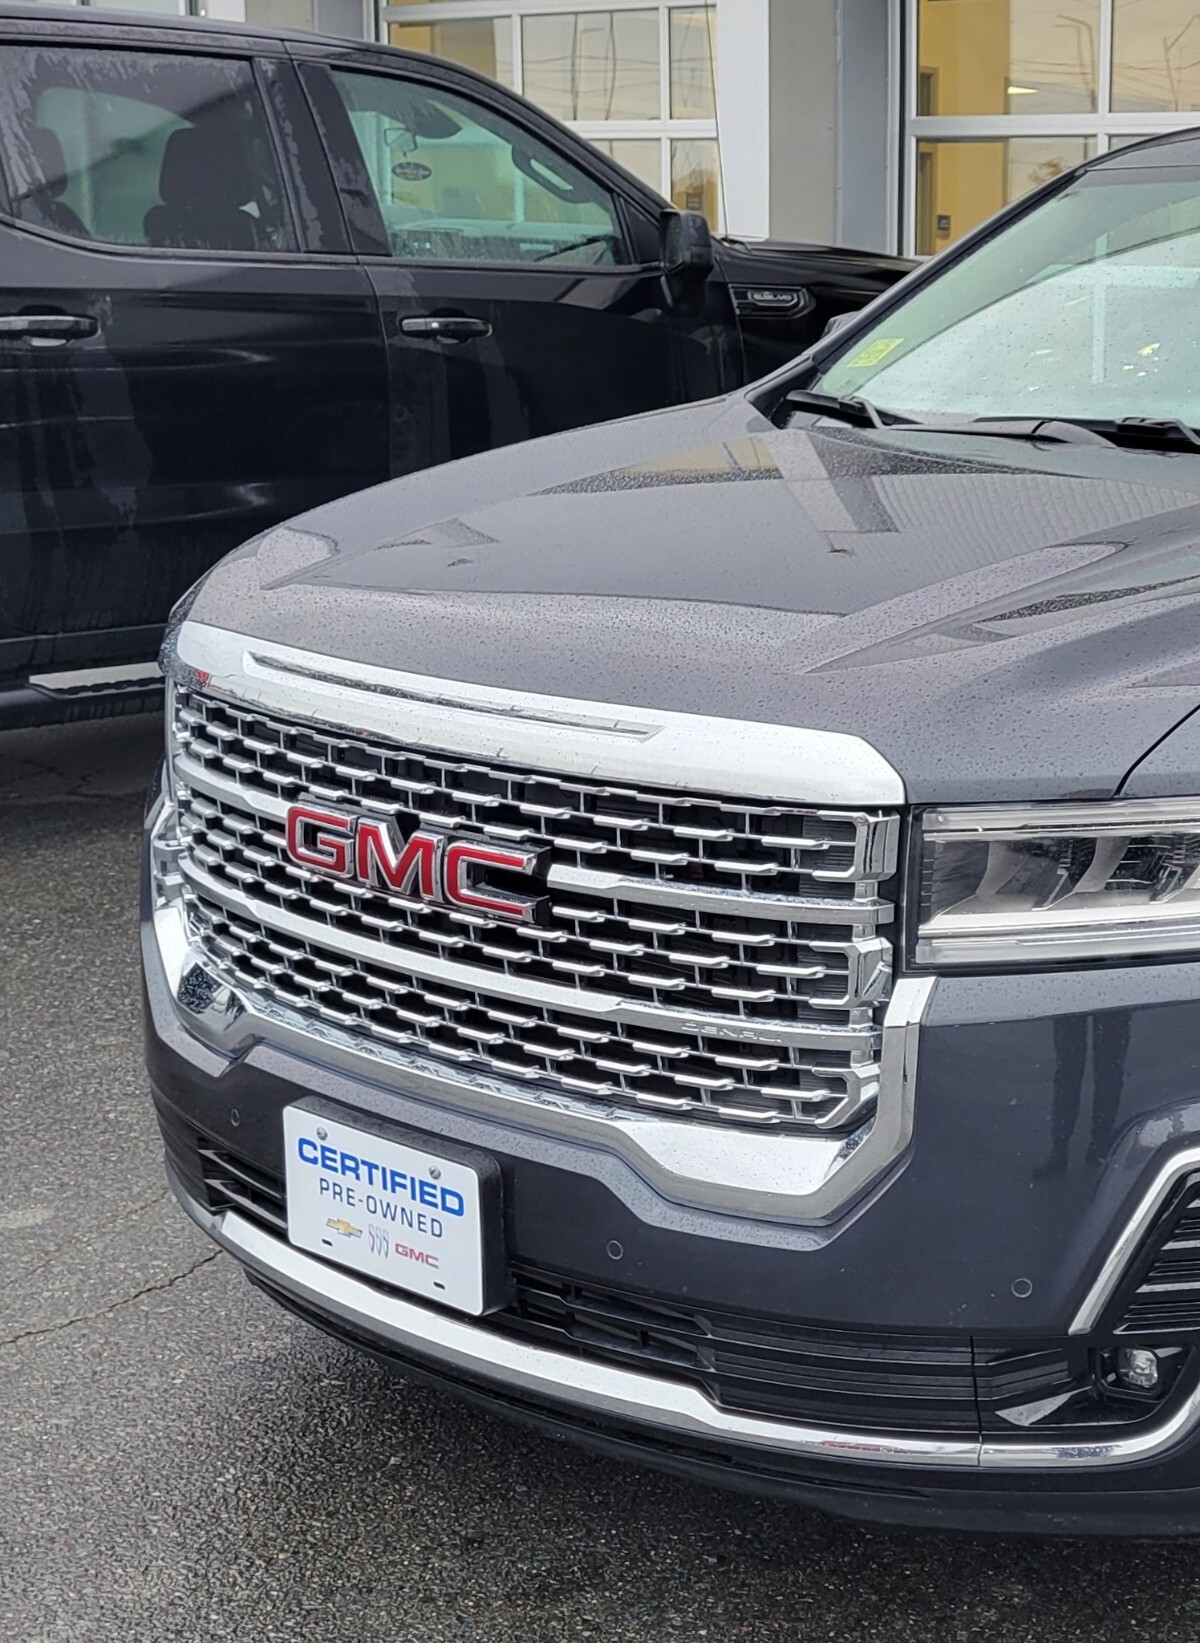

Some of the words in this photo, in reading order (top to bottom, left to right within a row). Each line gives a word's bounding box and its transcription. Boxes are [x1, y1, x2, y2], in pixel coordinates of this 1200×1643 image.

[287, 805, 538, 924] GMC
[298, 1137, 465, 1217] CERTIFIED
[319, 1177, 444, 1239] PRE-OWNED
[394, 1242, 440, 1270] GMC
